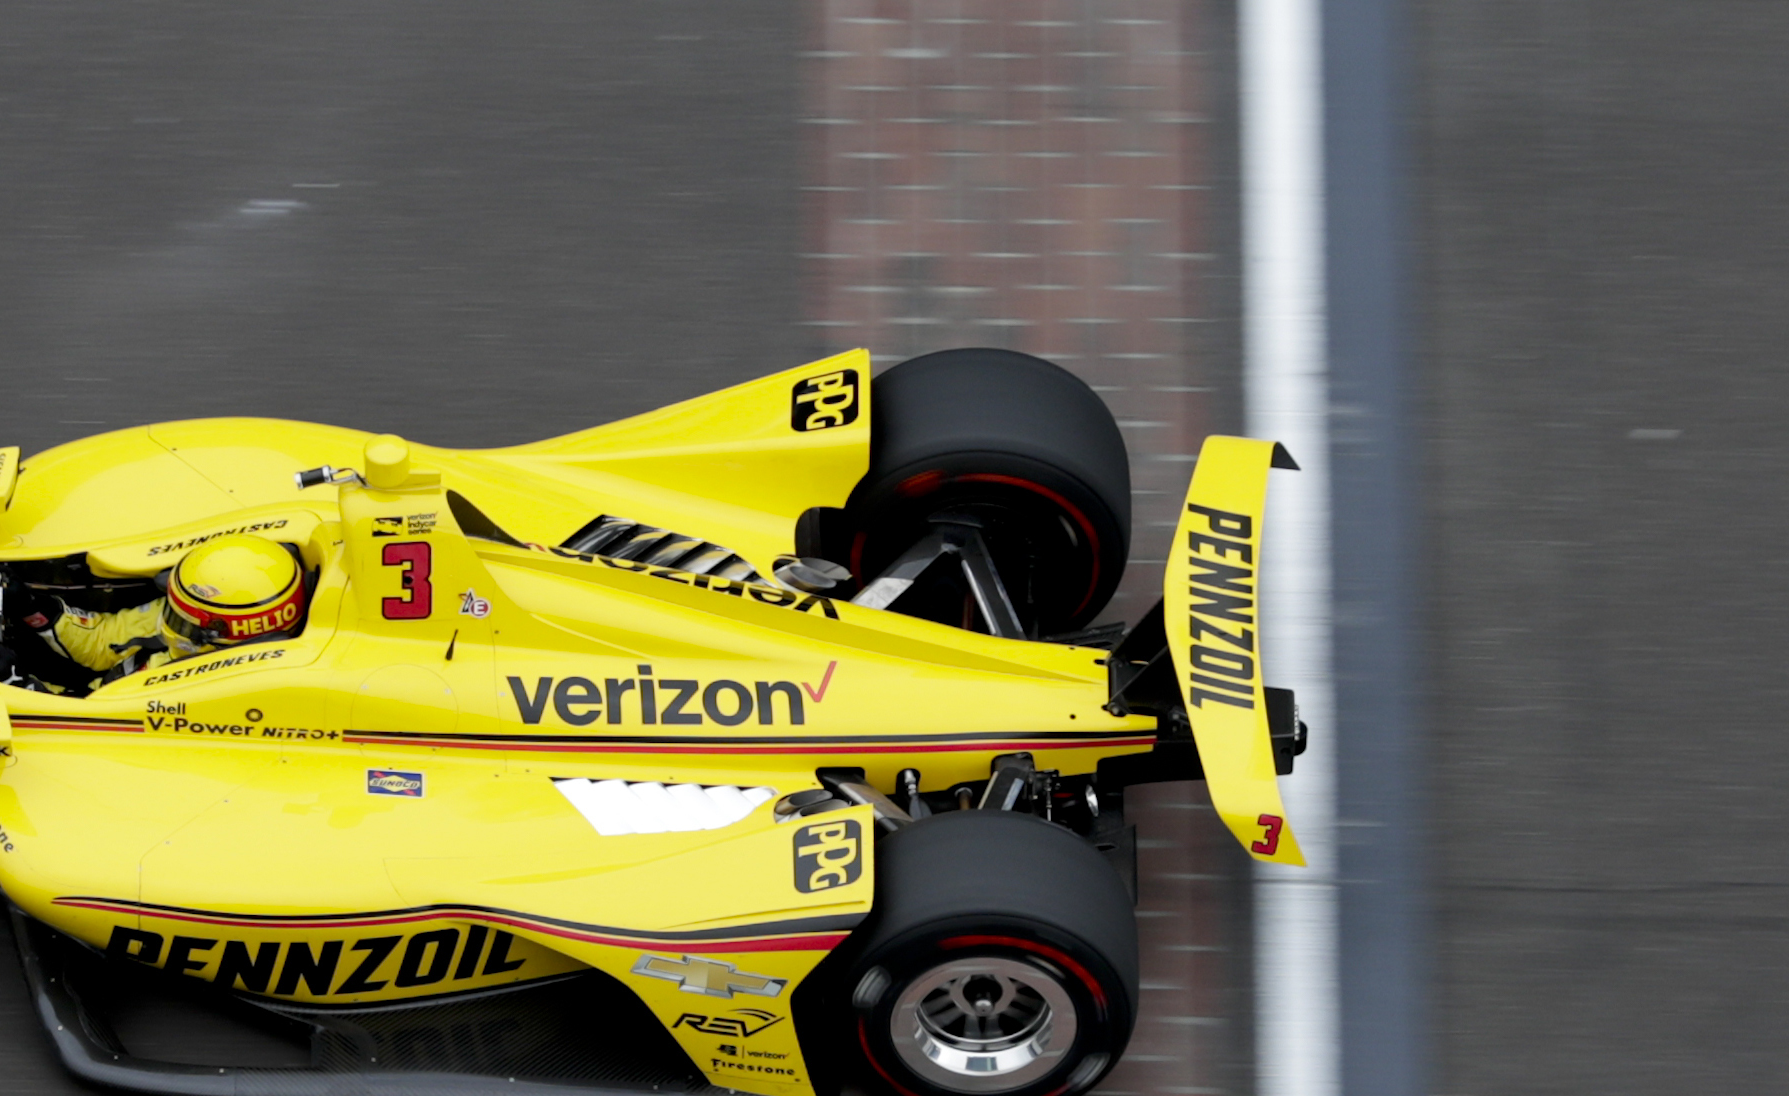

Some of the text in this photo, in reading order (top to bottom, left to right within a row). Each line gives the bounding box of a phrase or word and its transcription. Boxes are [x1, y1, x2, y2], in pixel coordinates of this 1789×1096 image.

[407, 512, 436, 521] verizon
[407, 520, 437, 529] indycar
[381, 541, 432, 620] 3
[1187, 502, 1255, 710] PENNZOIL
[231, 602, 297, 637] HELIO
[143, 650, 286, 687] CASTRONEVES
[146, 700, 186, 715] Shell
[507, 664, 805, 727] verizon
[146, 716, 255, 737] V-Power
[372, 779, 418, 789] SUNOCO
[1251, 813, 1283, 856] 3
[106, 925, 527, 996] PENNZOIL
[672, 1012, 785, 1037] REV
[710, 1058, 796, 1076] Firestone
[747, 1050, 786, 1060] verizon
